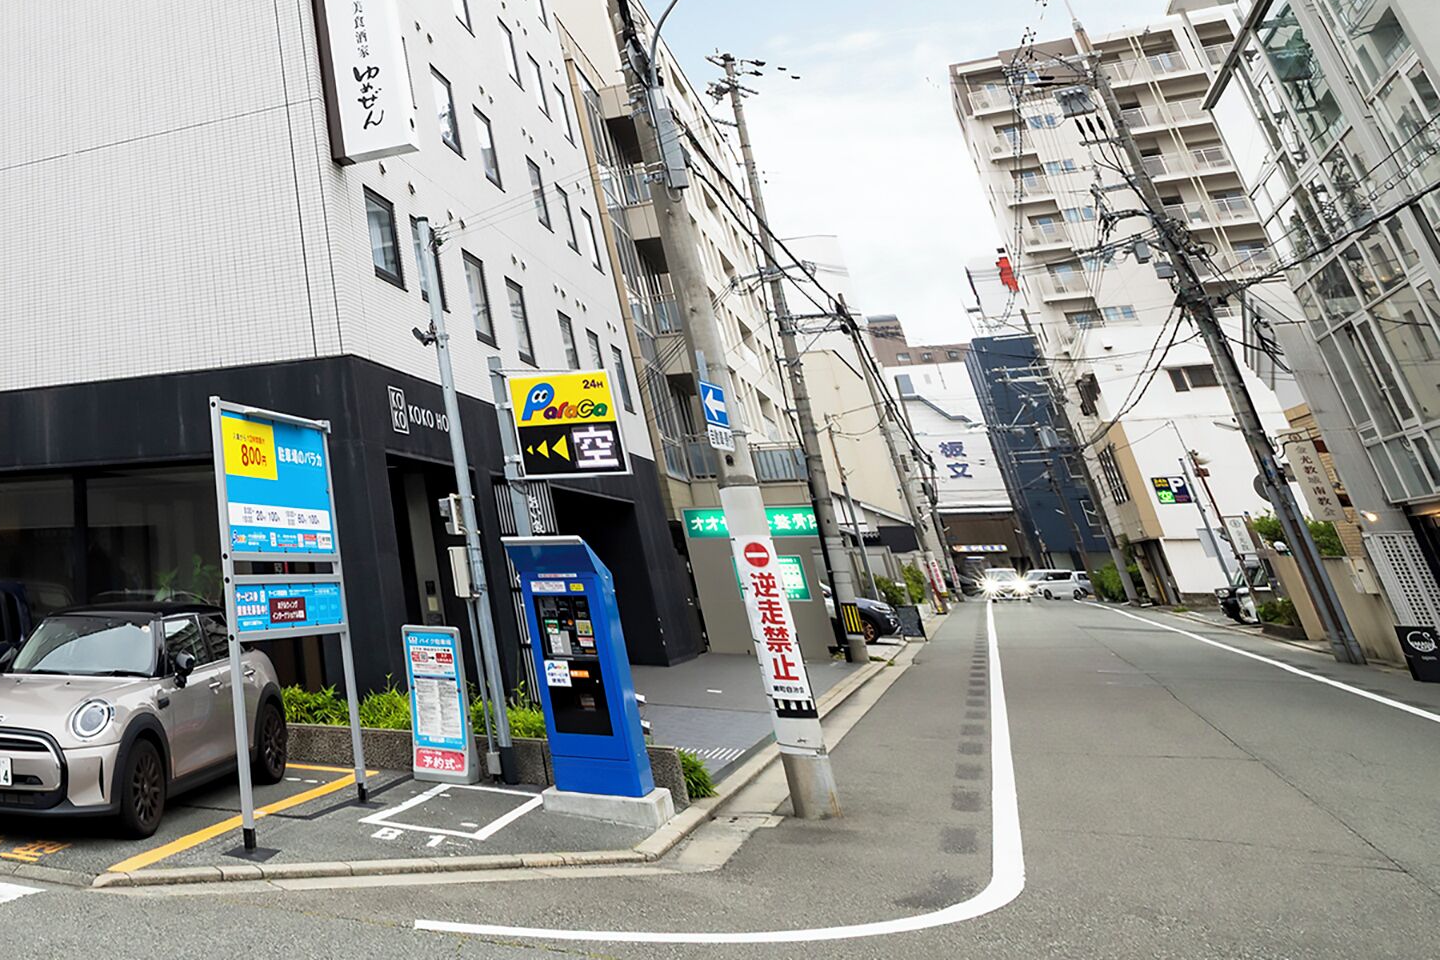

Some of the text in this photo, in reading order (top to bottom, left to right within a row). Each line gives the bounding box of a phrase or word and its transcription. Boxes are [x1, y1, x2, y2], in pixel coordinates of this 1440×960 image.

[582, 379, 604, 390] 24H
[408, 404, 434, 429] KOKO
[241, 444, 267, 467] 800円
[278, 446, 323, 467] 駐車場のパラカ
[572, 426, 619, 468] 空
[1167, 477, 1185, 493] P
[750, 572, 800, 682] 逆走禁止
